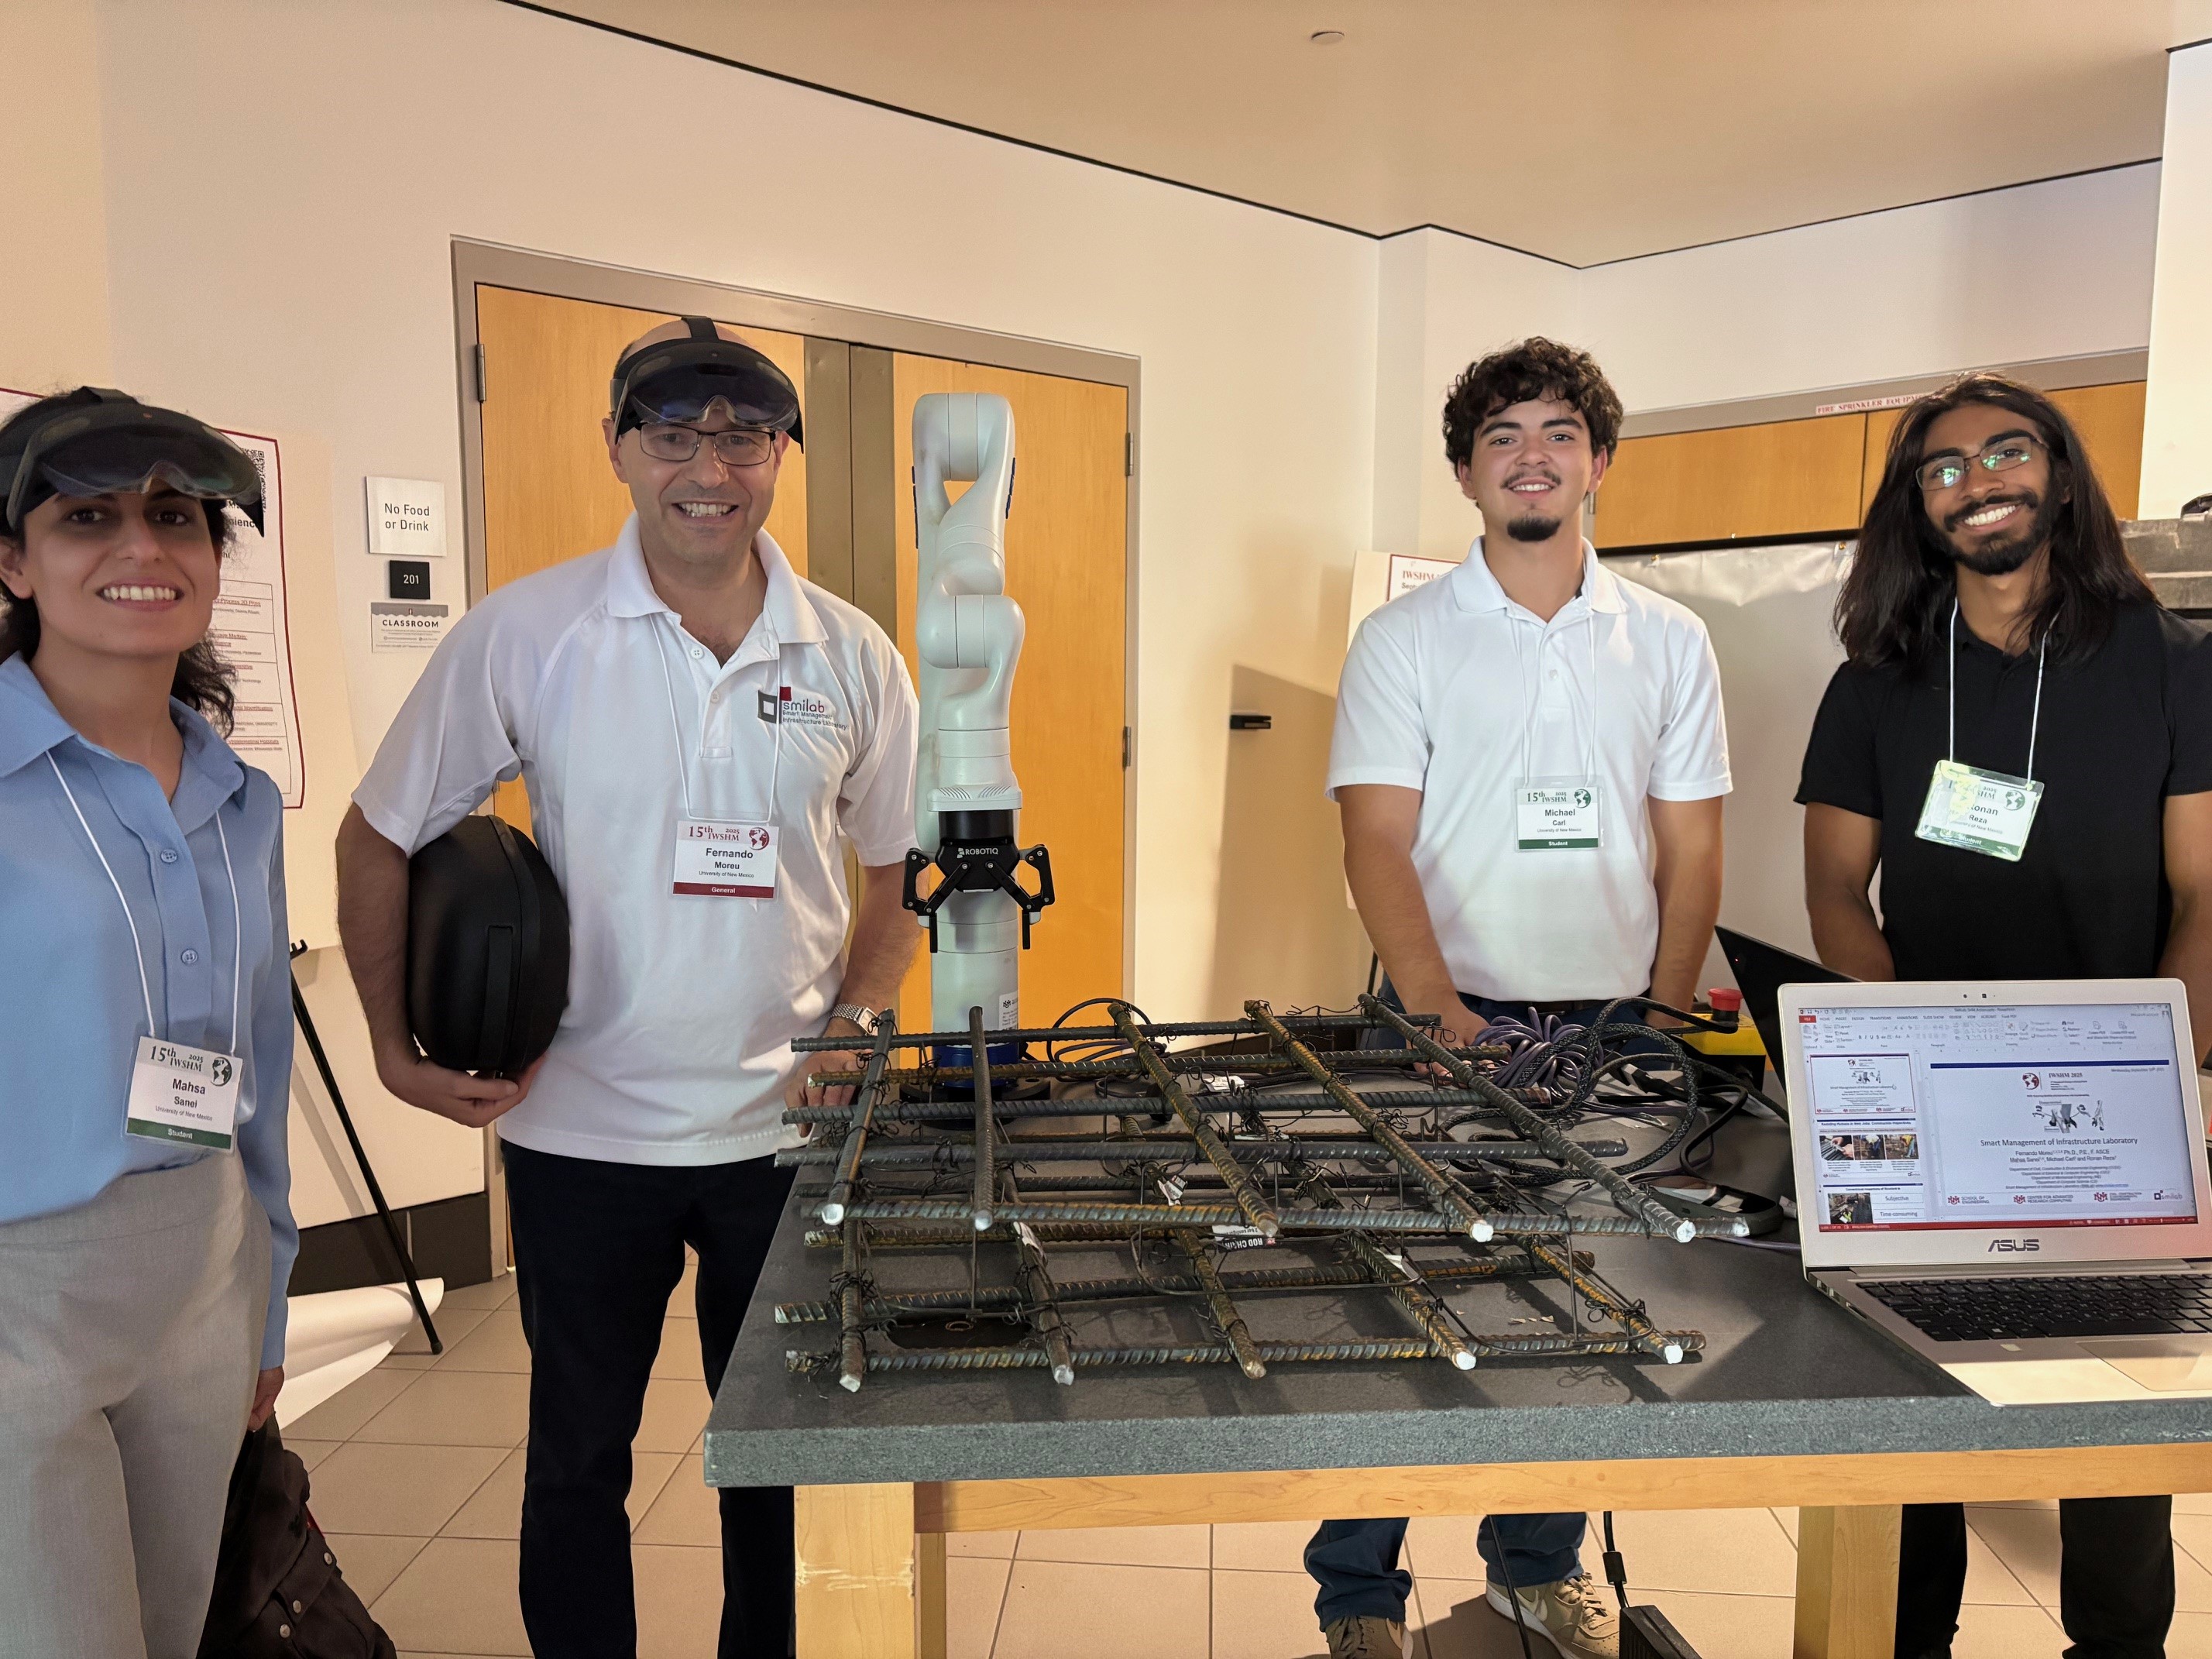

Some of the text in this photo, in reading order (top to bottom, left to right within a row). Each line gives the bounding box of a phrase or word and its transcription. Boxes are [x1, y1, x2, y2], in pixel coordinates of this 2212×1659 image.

[1839, 400, 1882, 411] SPRINKLER
[385, 503, 429, 516] No Food
[400, 520, 428, 531] Drink
[404, 575, 419, 584] 201
[784, 699, 825, 713] smilab
[1527, 791, 1545, 802] 15th
[1977, 790, 1995, 799] SHM
[1969, 815, 1987, 824] Reza
[689, 826, 713, 837] 15th
[706, 847, 753, 858] Fernando
[150, 1046, 204, 1063] 15th 2025
[170, 1057, 201, 1072] IWSHM
[173, 1078, 206, 1094] Mahsa
[174, 1096, 198, 1108] Sanei
[156, 1105, 178, 1116] University
[168, 1128, 192, 1139] Student
[2002, 1139, 2046, 1148] Management
[1988, 1238, 2039, 1252] ASUS
